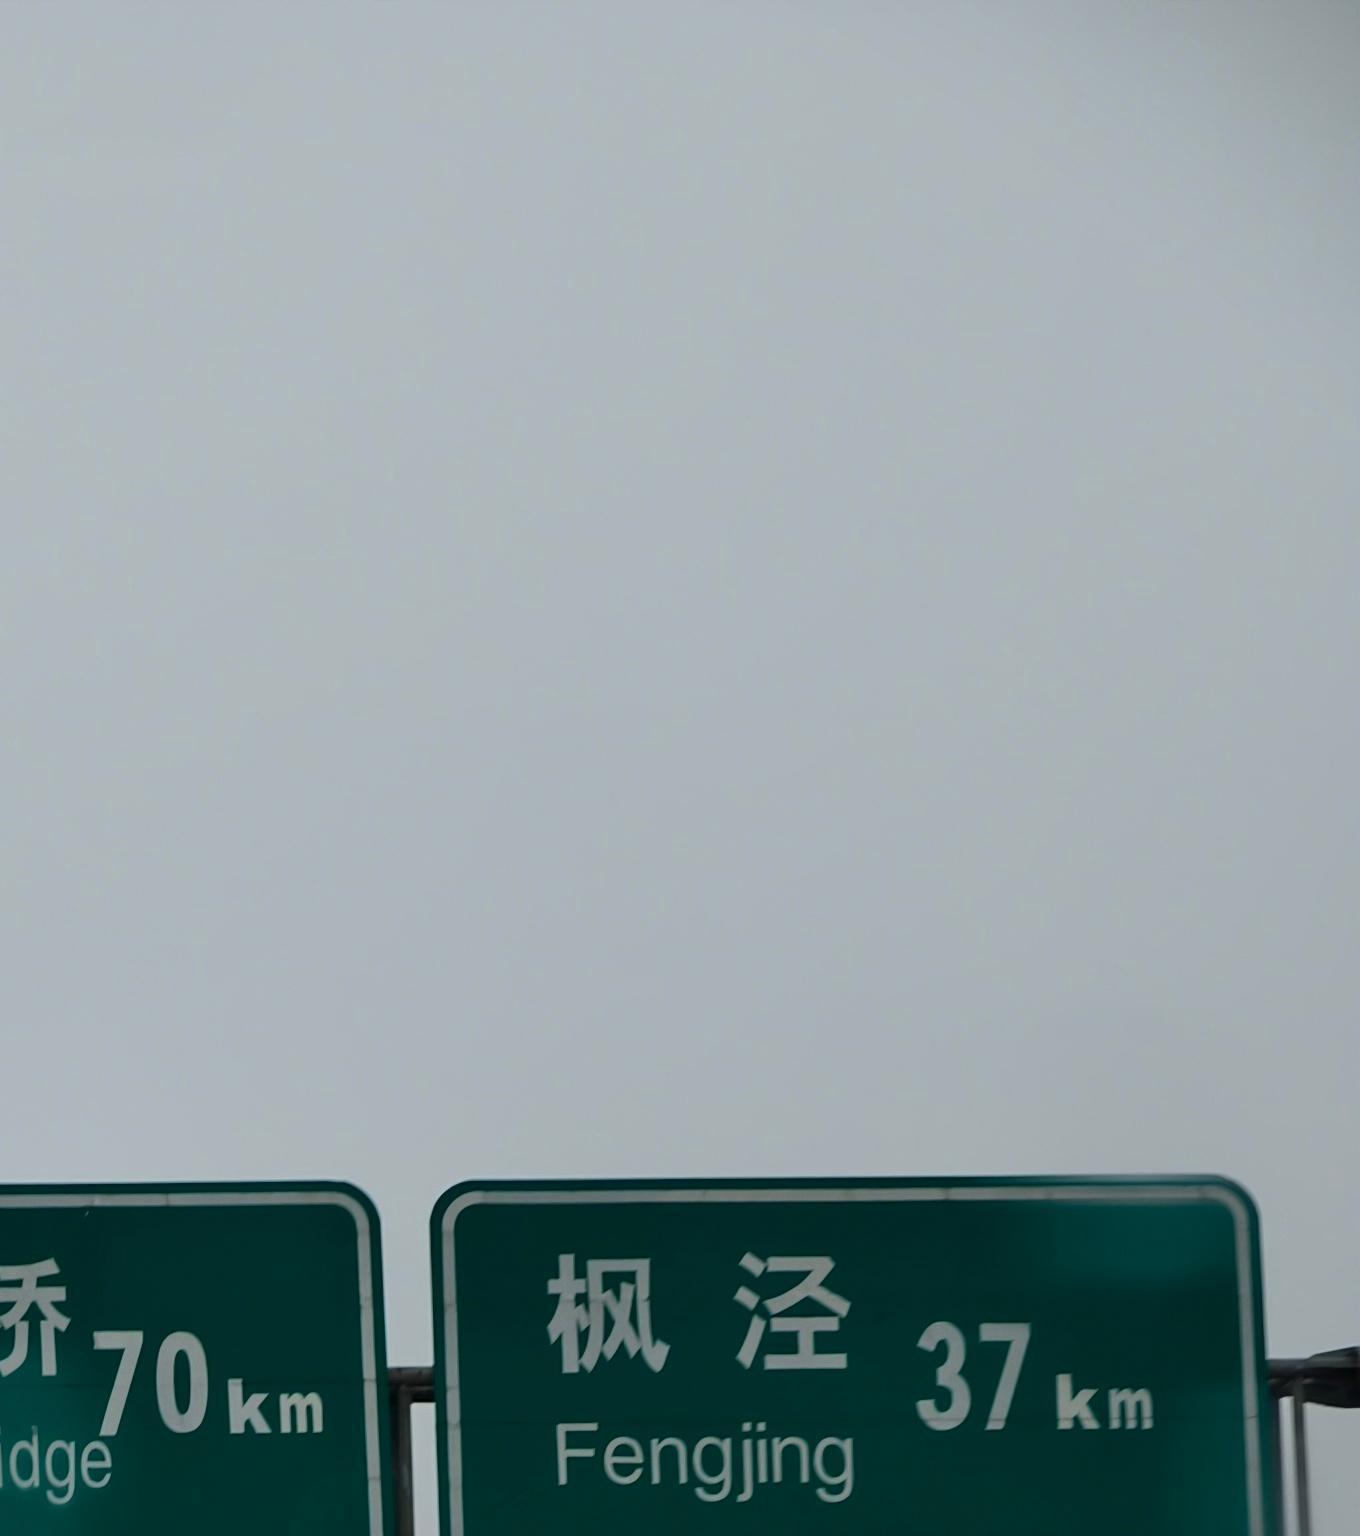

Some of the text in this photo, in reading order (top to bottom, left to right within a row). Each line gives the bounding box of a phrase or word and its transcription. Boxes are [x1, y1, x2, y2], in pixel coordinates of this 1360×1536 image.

[546, 1252, 851, 1374] 枫泾
[92, 1330, 324, 1436] 70 km
[915, 1321, 1154, 1431] 37 km
[556, 1421, 854, 1503] Fengjing
